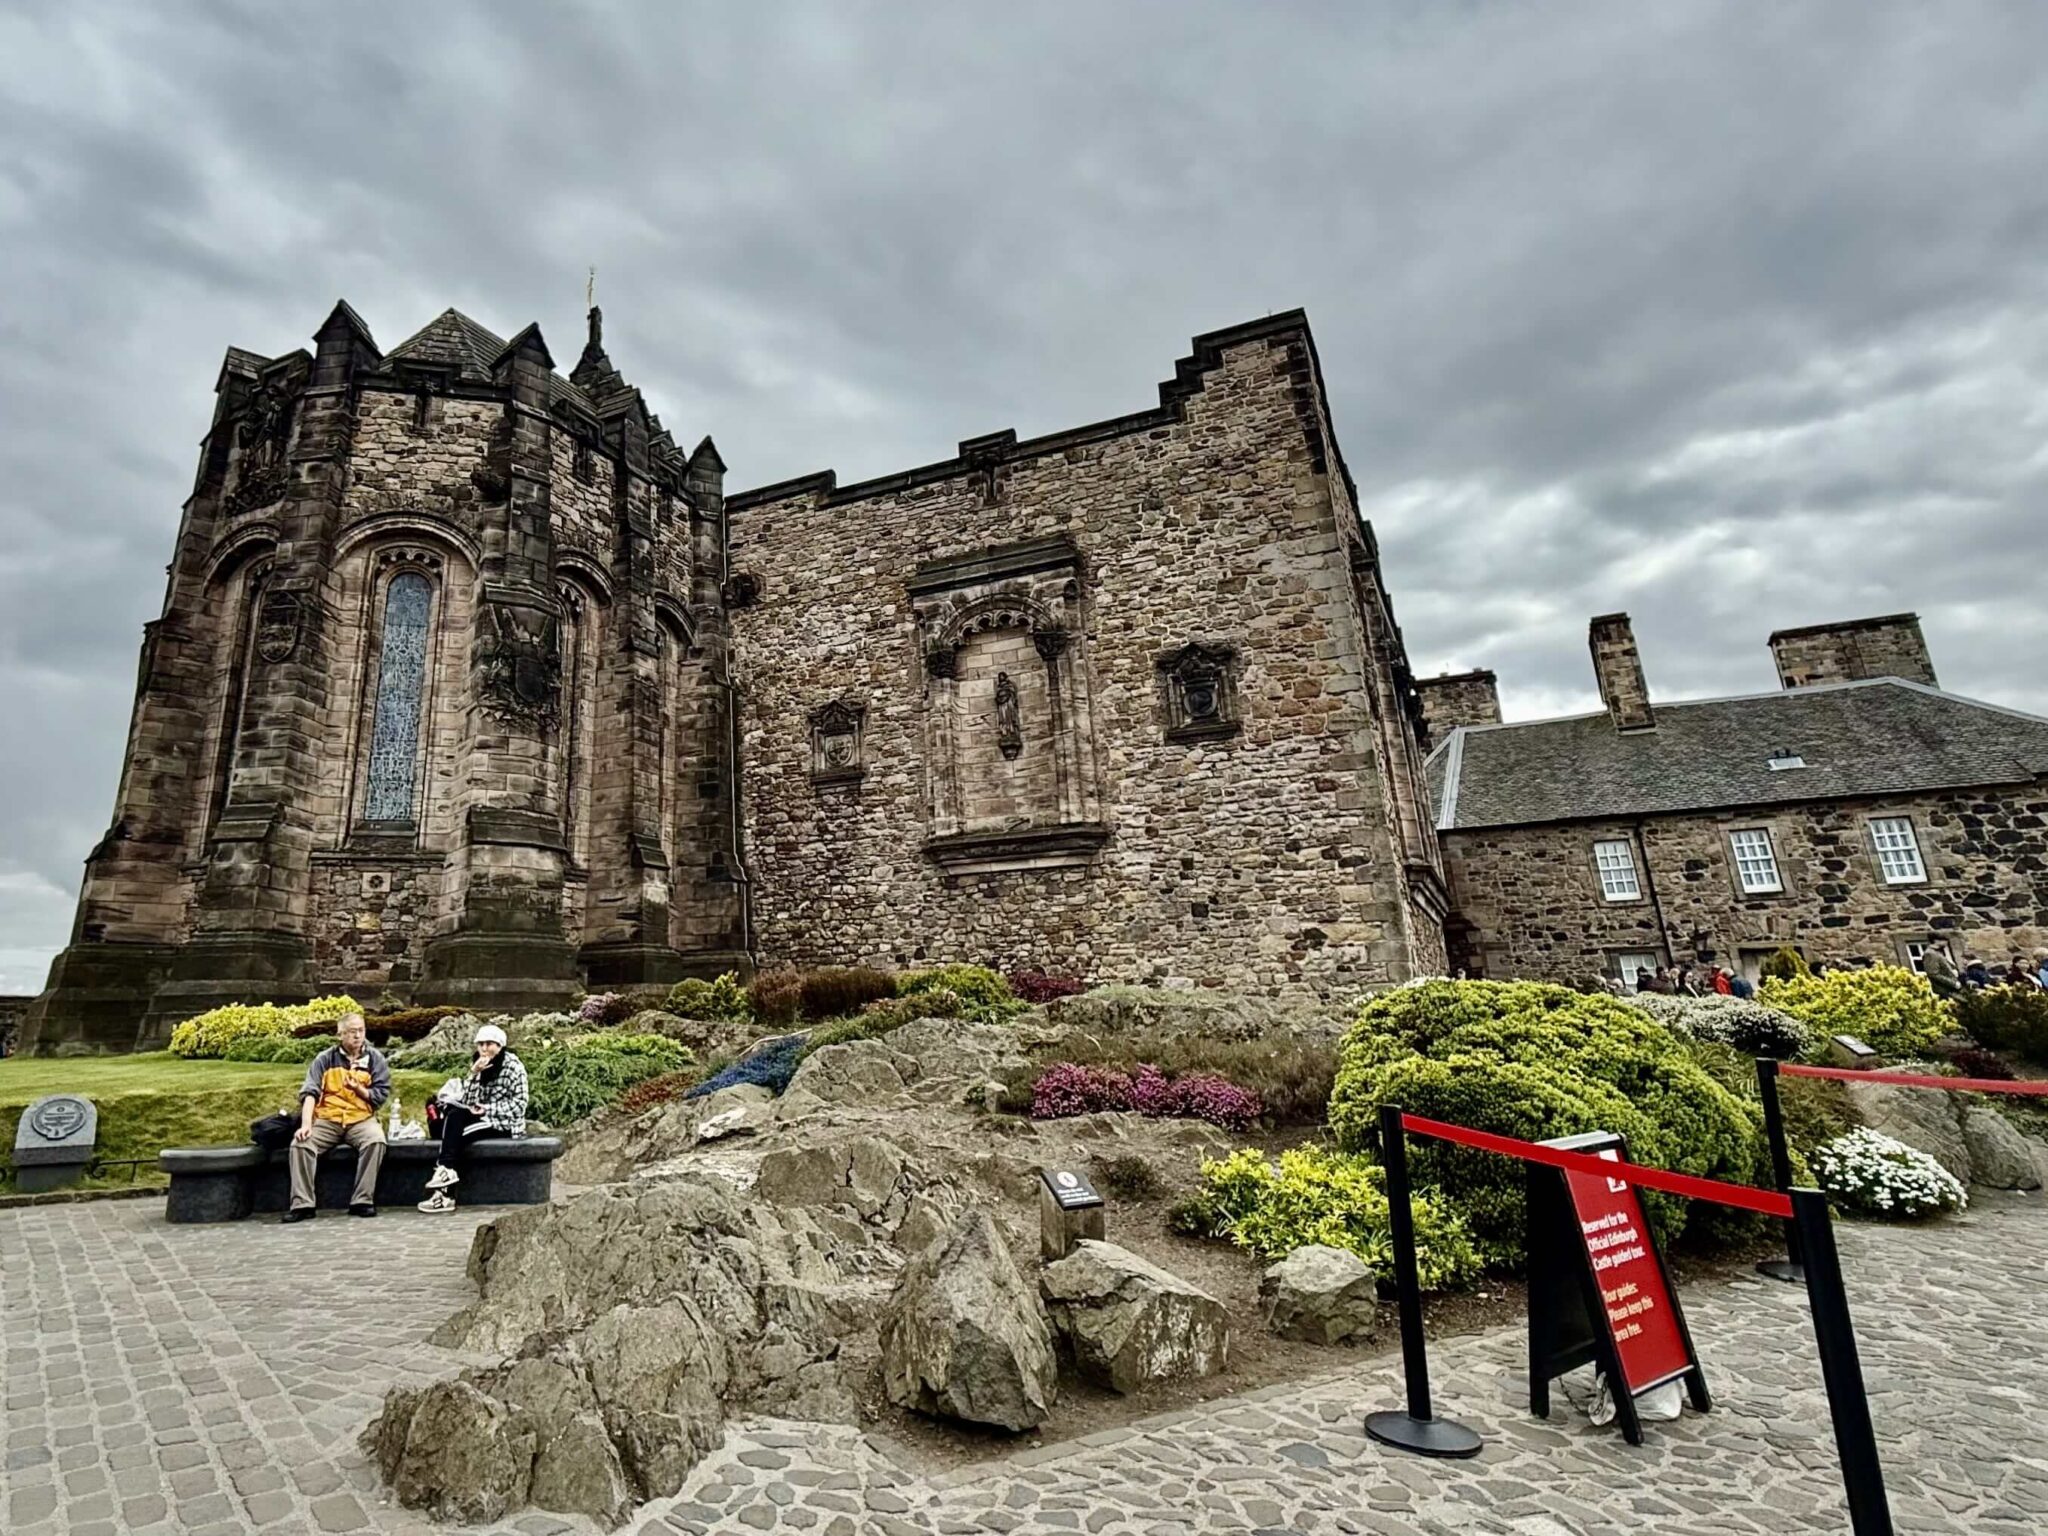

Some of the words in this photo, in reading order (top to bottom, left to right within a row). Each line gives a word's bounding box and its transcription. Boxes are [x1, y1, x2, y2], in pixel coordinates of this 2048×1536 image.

[1608, 1213, 1618, 1227] for
[1617, 1211, 1628, 1225] the
[1587, 1235, 1610, 1252] Official
[1608, 1227, 1638, 1246] Edinburgh
[1593, 1255, 1613, 1271] Castle
[1612, 1248, 1632, 1268] guided
[1631, 1245, 1646, 1259] tour.
[1602, 1290, 1617, 1303] Tour
[1616, 1282, 1638, 1301] guides:
[1607, 1307, 1629, 1323] Please
[1627, 1301, 1643, 1315] keep
[1640, 1295, 1654, 1310] this
[1614, 1329, 1629, 1342] area
[1626, 1322, 1643, 1338] free.
